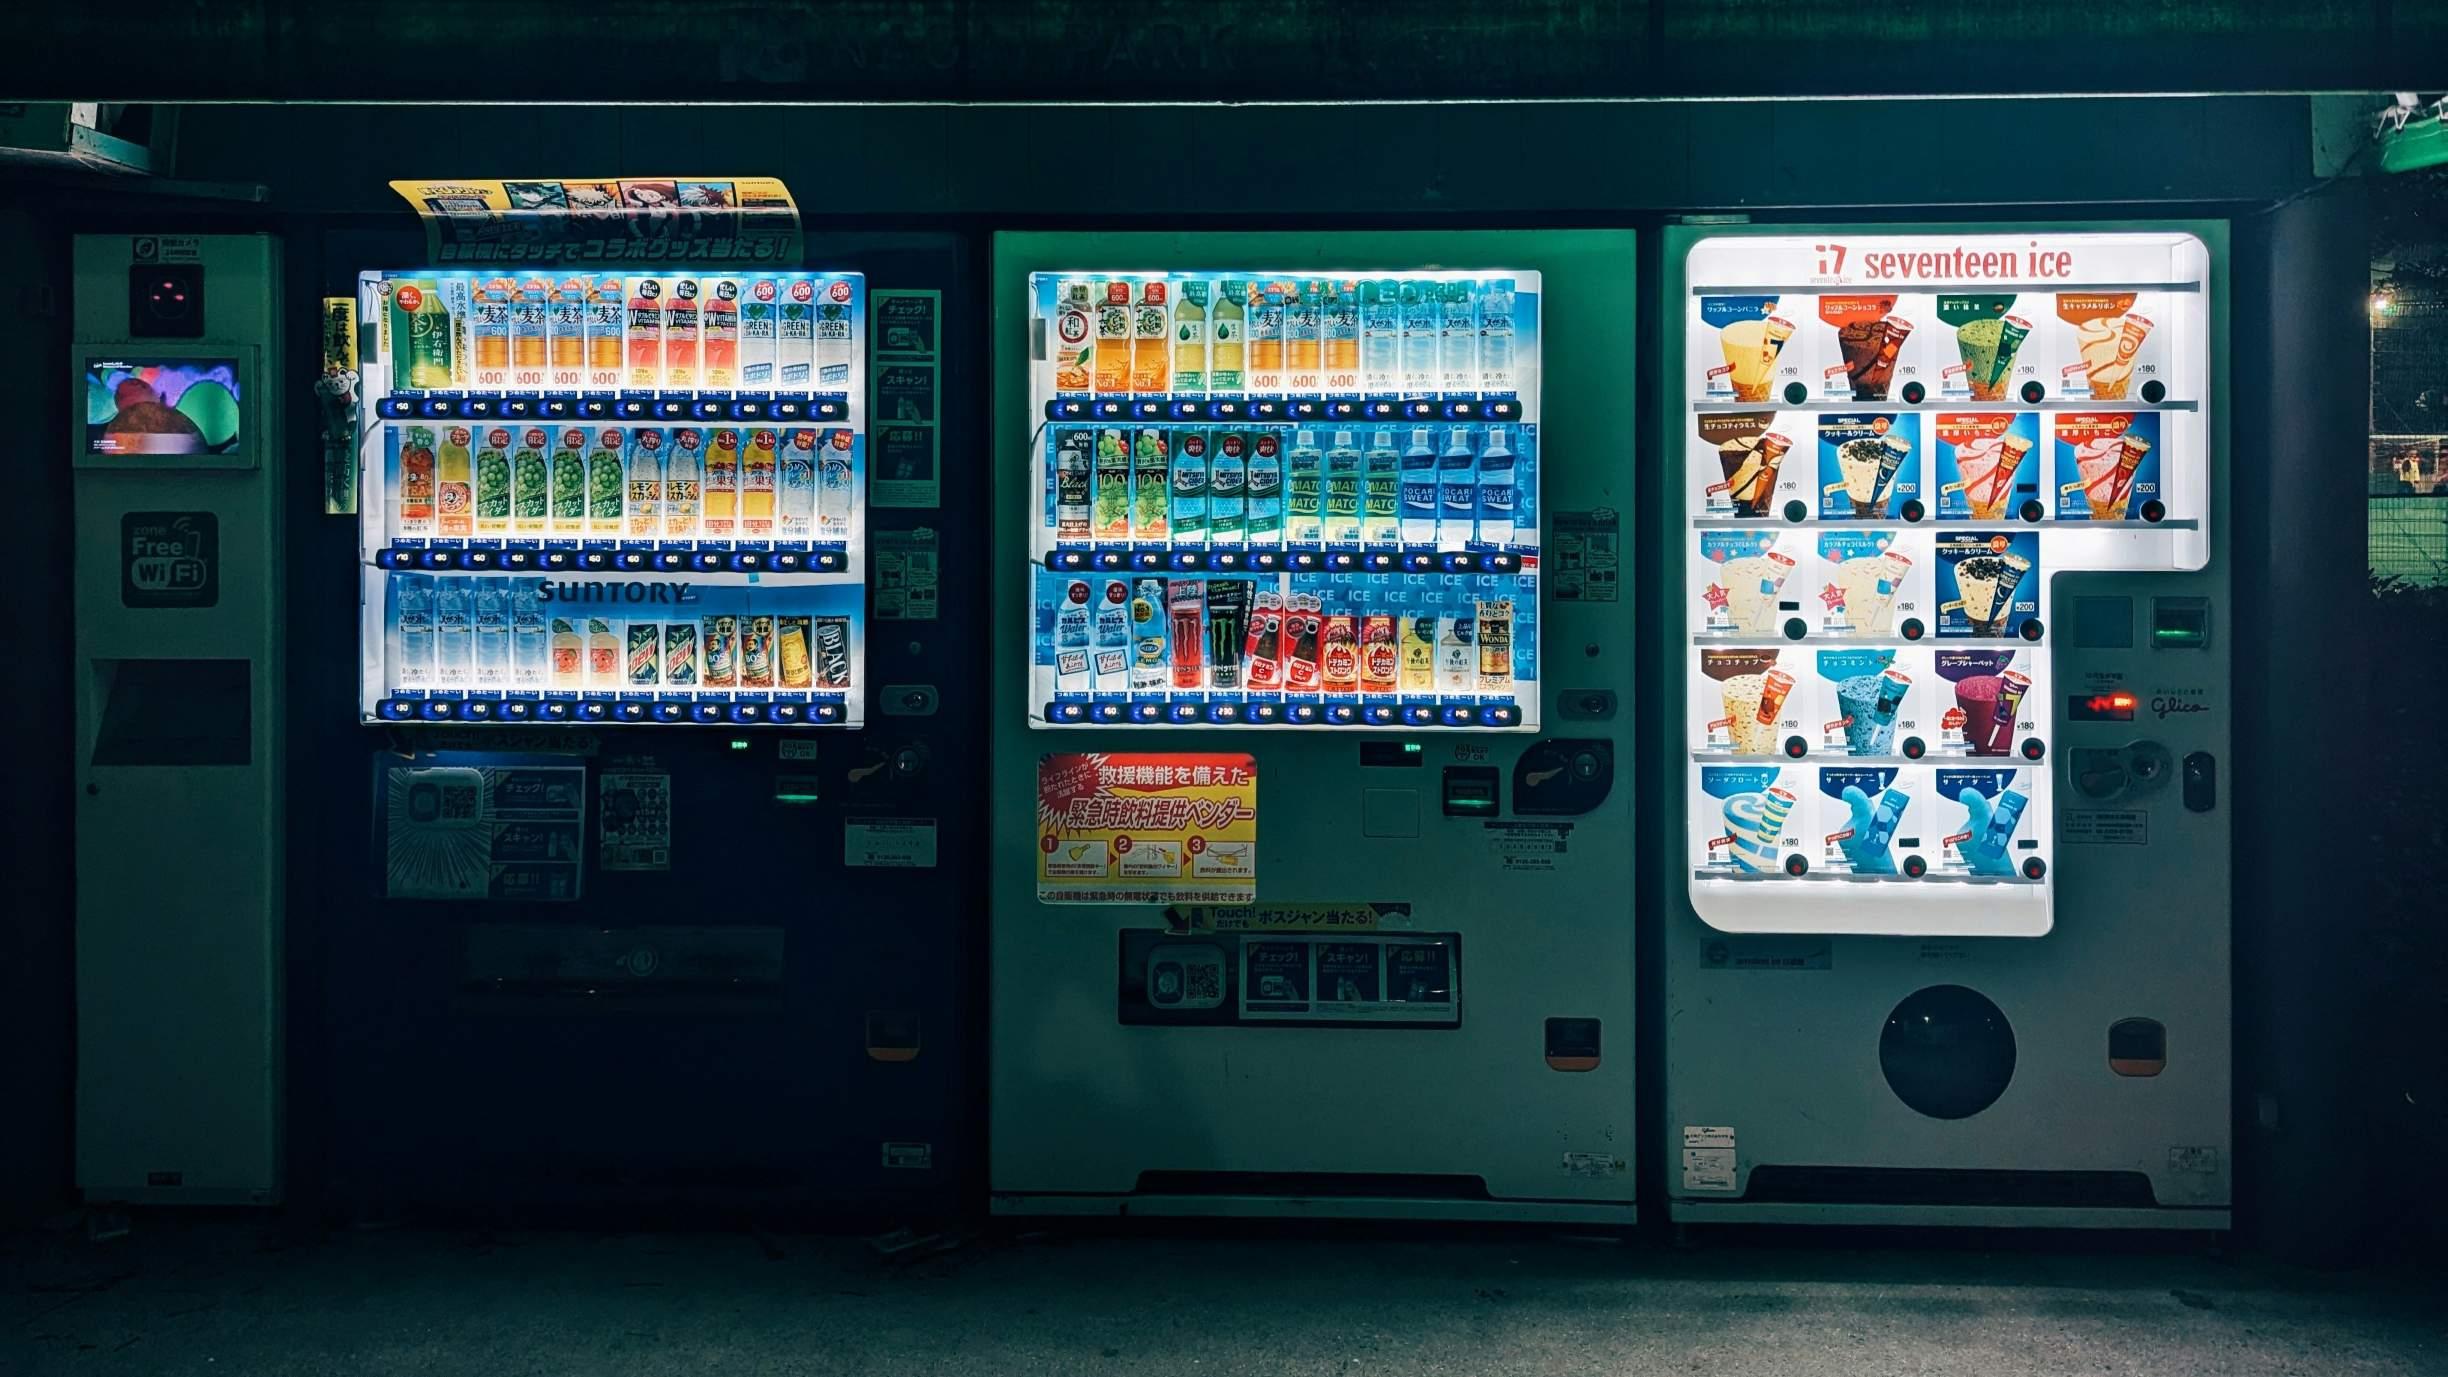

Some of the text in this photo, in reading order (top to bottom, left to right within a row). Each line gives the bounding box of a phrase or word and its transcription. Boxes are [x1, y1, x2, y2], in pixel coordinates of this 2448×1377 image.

[1865, 241, 2072, 279] seventeen ice
[757, 287, 773, 297] 600
[794, 287, 811, 297] 600
[832, 287, 849, 297] 600
[1111, 294, 1124, 302] 600
[1147, 294, 1160, 302] 600
[484, 305, 508, 323] 麦茶
[522, 305, 545, 323] 麦茶
[560, 305, 583, 323] 麦茶
[598, 305, 622, 323] 麦茶
[1067, 316, 1080, 328] 和
[478, 372, 502, 385] 600
[516, 372, 540, 385] 600
[554, 372, 578, 385] 600
[592, 372, 617, 385] 600
[1254, 375, 1278, 388] 600
[1292, 375, 1316, 388] 600
[1061, 475, 1088, 489] Black
[1098, 473, 1126, 489] 100
[1137, 473, 1164, 489] 100
[1404, 494, 1433, 502] SWEAT
[1482, 496, 1512, 504] SWEAT
[132, 537, 184, 556] Free
[1294, 573, 1317, 583] ICE
[1330, 573, 1353, 584] ICE
[1367, 574, 1389, 584] ICE
[1403, 574, 1425, 585] ICE
[1439, 575, 1462, 586] ICE
[1476, 575, 1499, 587] ICE
[1513, 576, 1535, 587] ICE
[539, 580, 690, 604] SUNTORY
[1177, 585, 1198, 597] 上陸
[1060, 624, 1087, 634] Water
[1098, 624, 1125, 634] Water
[1479, 633, 1509, 645] WONDA
[709, 652, 730, 663] BOSS
[746, 652, 767, 663] BOSS
[823, 630, 849, 686] BLACK
[2151, 696, 2210, 719] Glico
[1099, 766, 1249, 786] 救援機能を備えた
[1068, 798, 1255, 830] 緊急時飲料提供ベンダー
[1119, 838, 1128, 850] 2
[1192, 838, 1201, 850] 3
[1211, 906, 1256, 920] Touch!
[1259, 908, 1373, 925] ボスジャン当たる!
